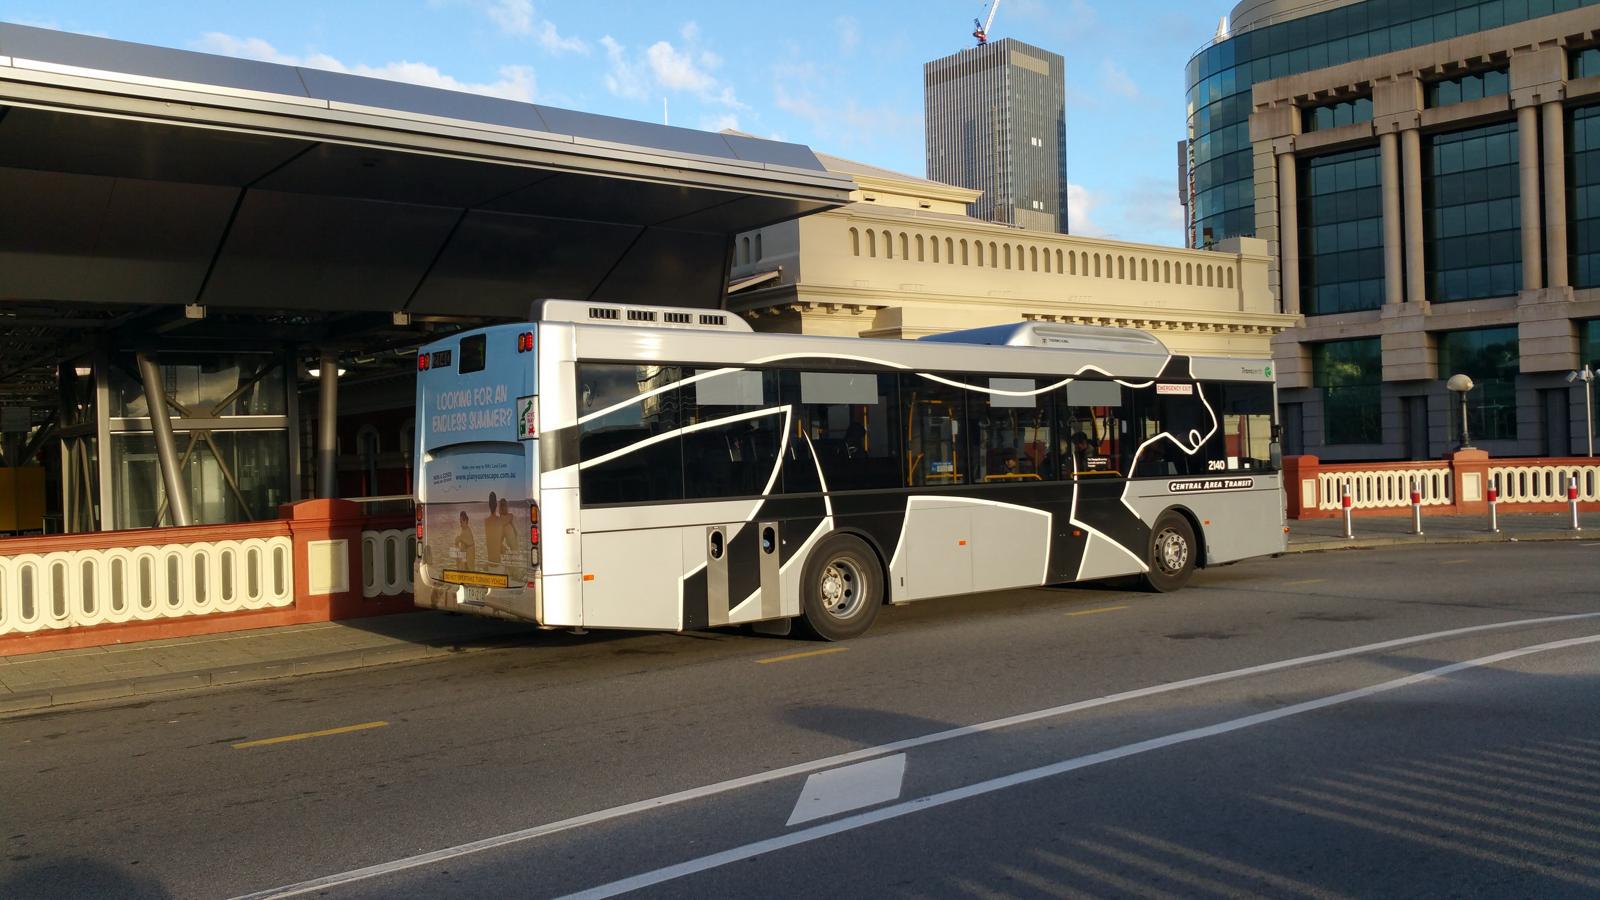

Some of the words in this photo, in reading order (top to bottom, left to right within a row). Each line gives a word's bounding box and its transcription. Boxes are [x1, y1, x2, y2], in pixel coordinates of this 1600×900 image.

[437, 389, 471, 410] LOOKING
[474, 387, 492, 406] FOR
[495, 384, 508, 403] AN
[432, 412, 467, 433] ENDLESS
[469, 408, 513, 431] SUMMER?
[1208, 460, 1225, 470] 2140
[1171, 482, 1202, 491] CENTRAL
[1204, 481, 1223, 489] AREA
[1224, 480, 1252, 488] TRANSIT
